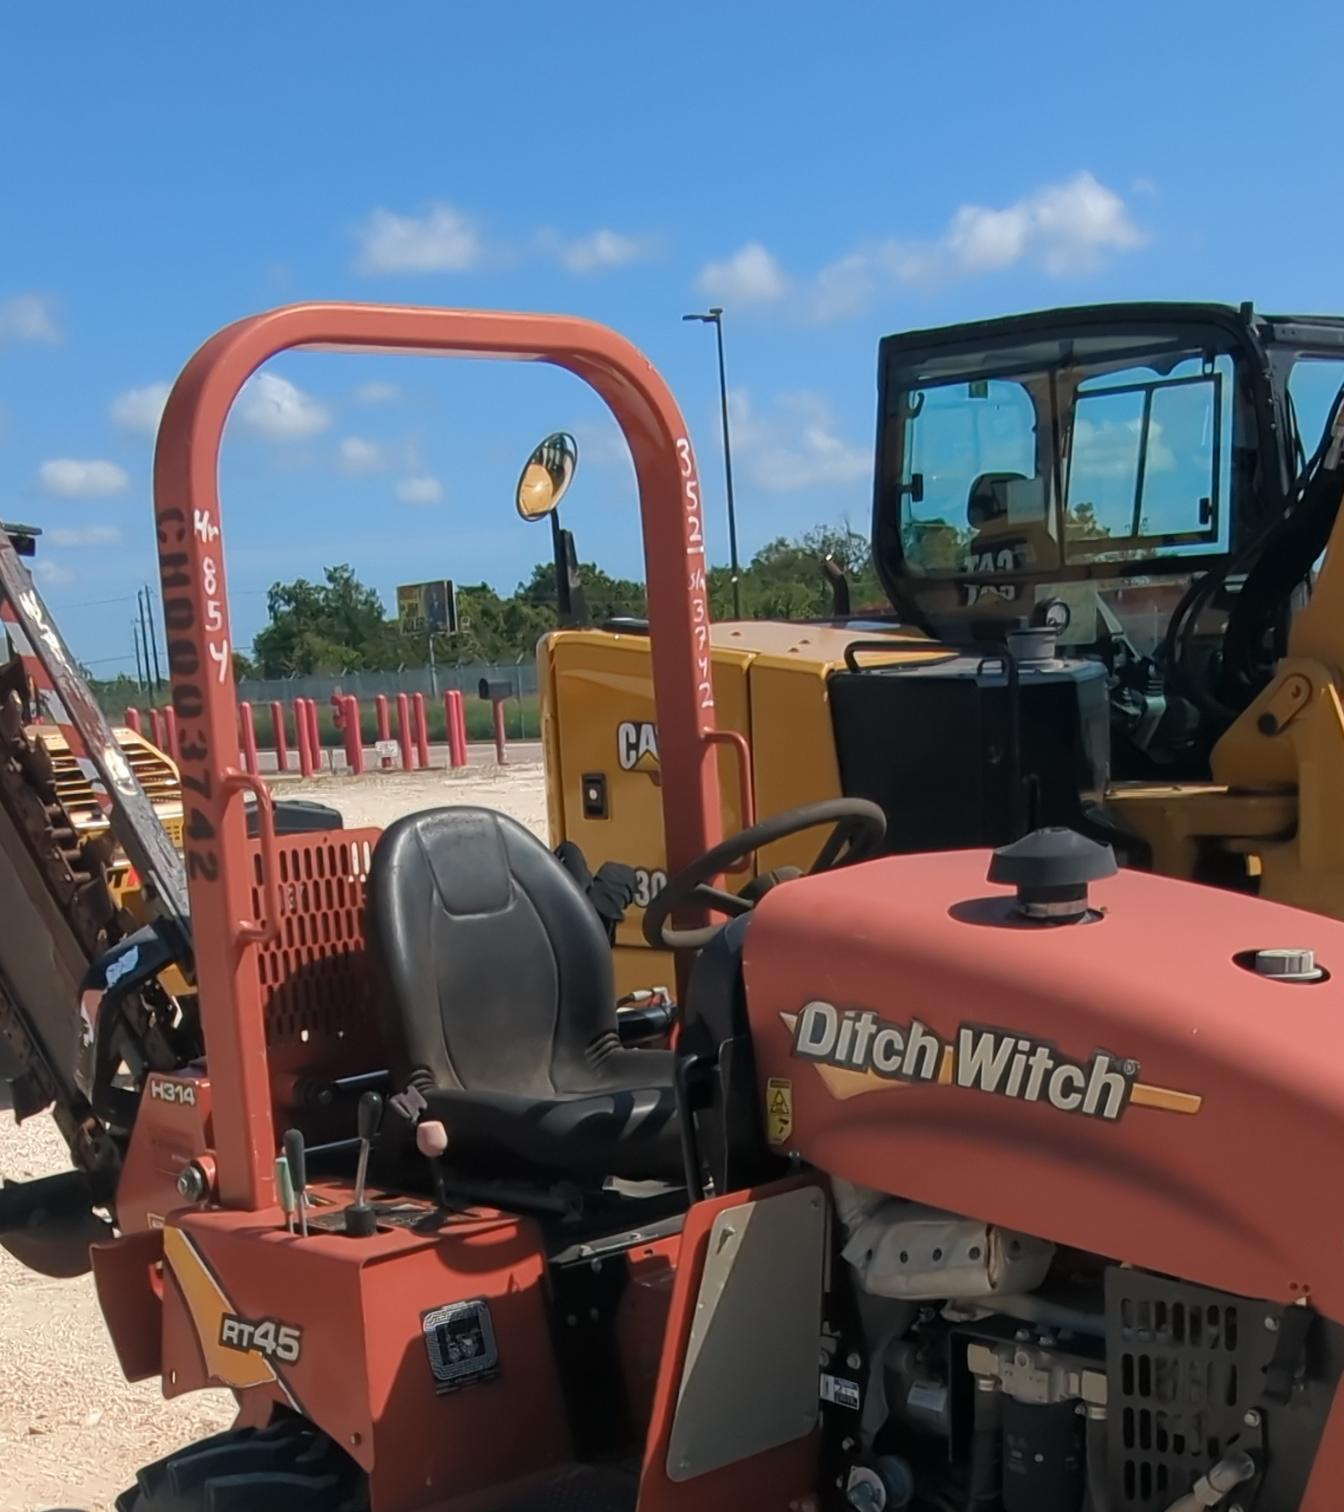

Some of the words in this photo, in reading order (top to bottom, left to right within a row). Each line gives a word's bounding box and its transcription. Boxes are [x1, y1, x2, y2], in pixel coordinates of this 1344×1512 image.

[692, 598, 714, 708] 3742
[157, 508, 219, 882] CH0003742
[618, 722, 659, 769] CA
[151, 1080, 195, 1106] H314
[797, 1001, 939, 1079] Ditch
[958, 1028, 1126, 1119] Witch
[223, 1318, 300, 1361] RT45
